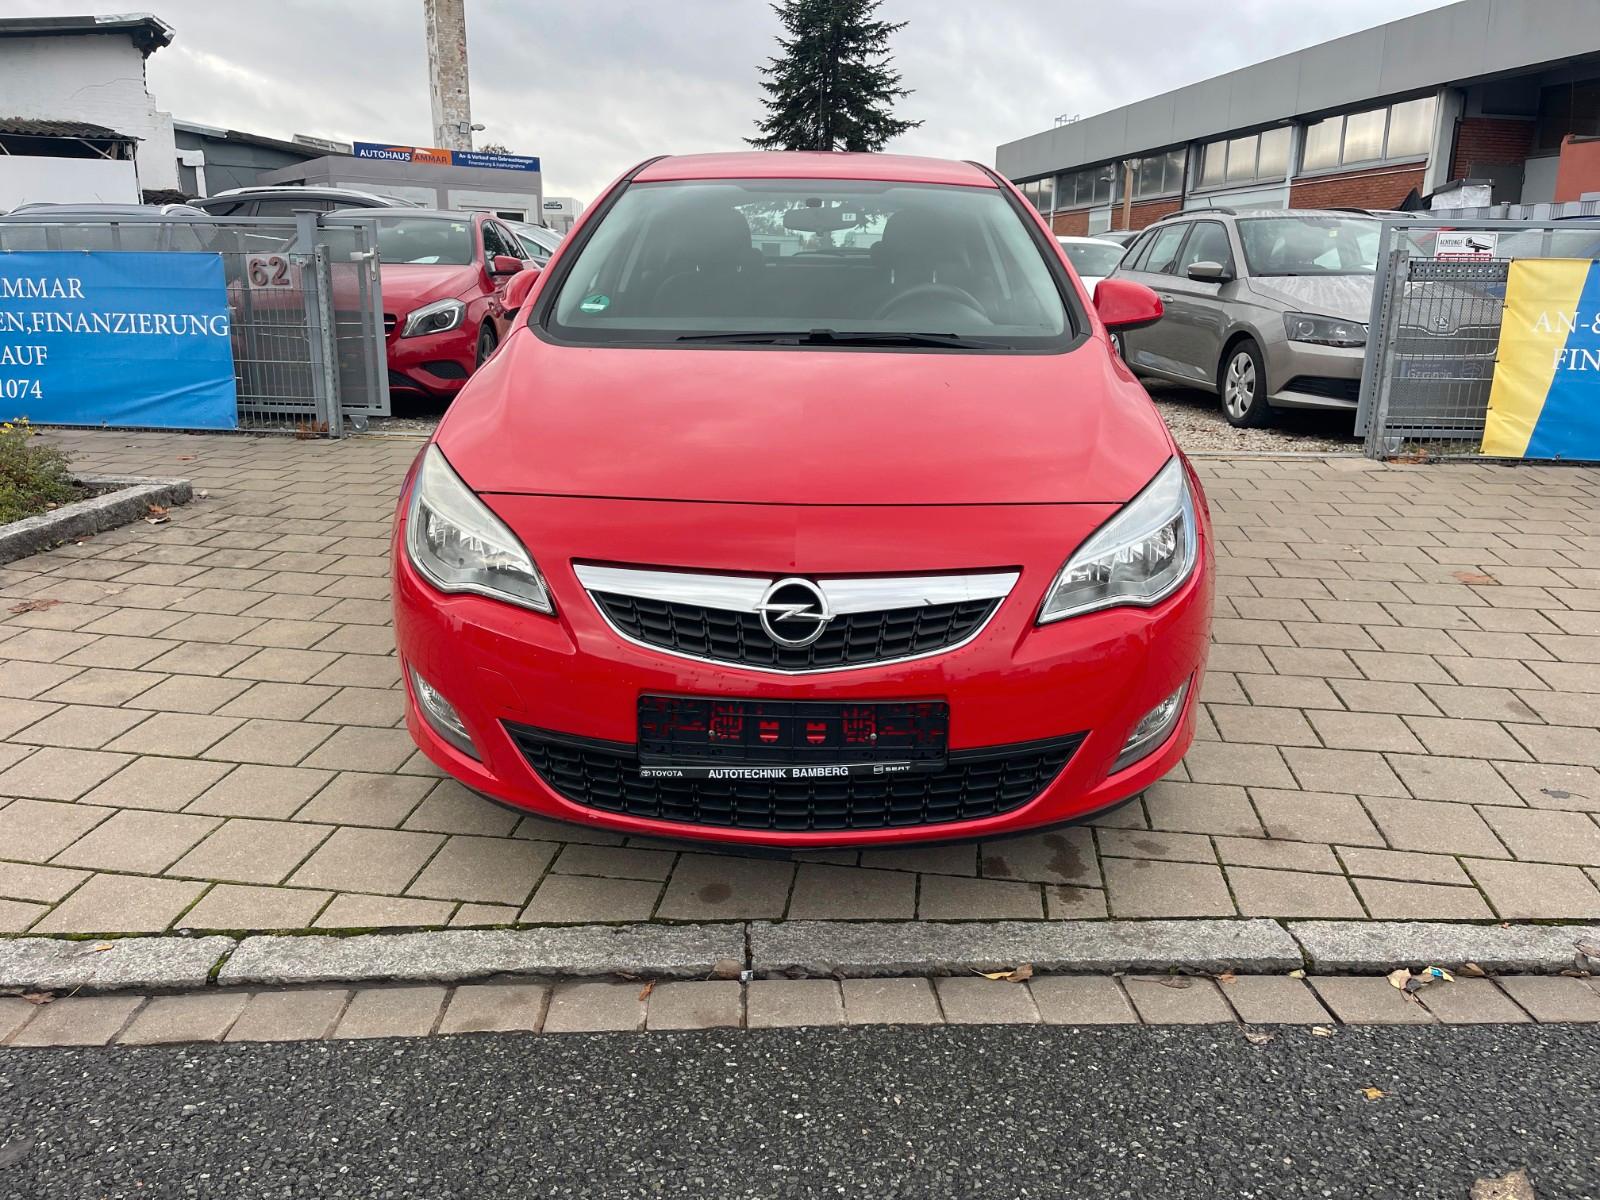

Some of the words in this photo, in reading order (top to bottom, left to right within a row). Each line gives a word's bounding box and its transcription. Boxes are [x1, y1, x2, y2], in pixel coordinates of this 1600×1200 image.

[360, 148, 411, 161] AUTOHAUS
[414, 154, 448, 165] AMMAR
[249, 255, 289, 287] 62
[0, 277, 85, 300] MMAR
[708, 768, 786, 779] AUTOTECHNIK
[792, 766, 849, 778] BAMBERG
